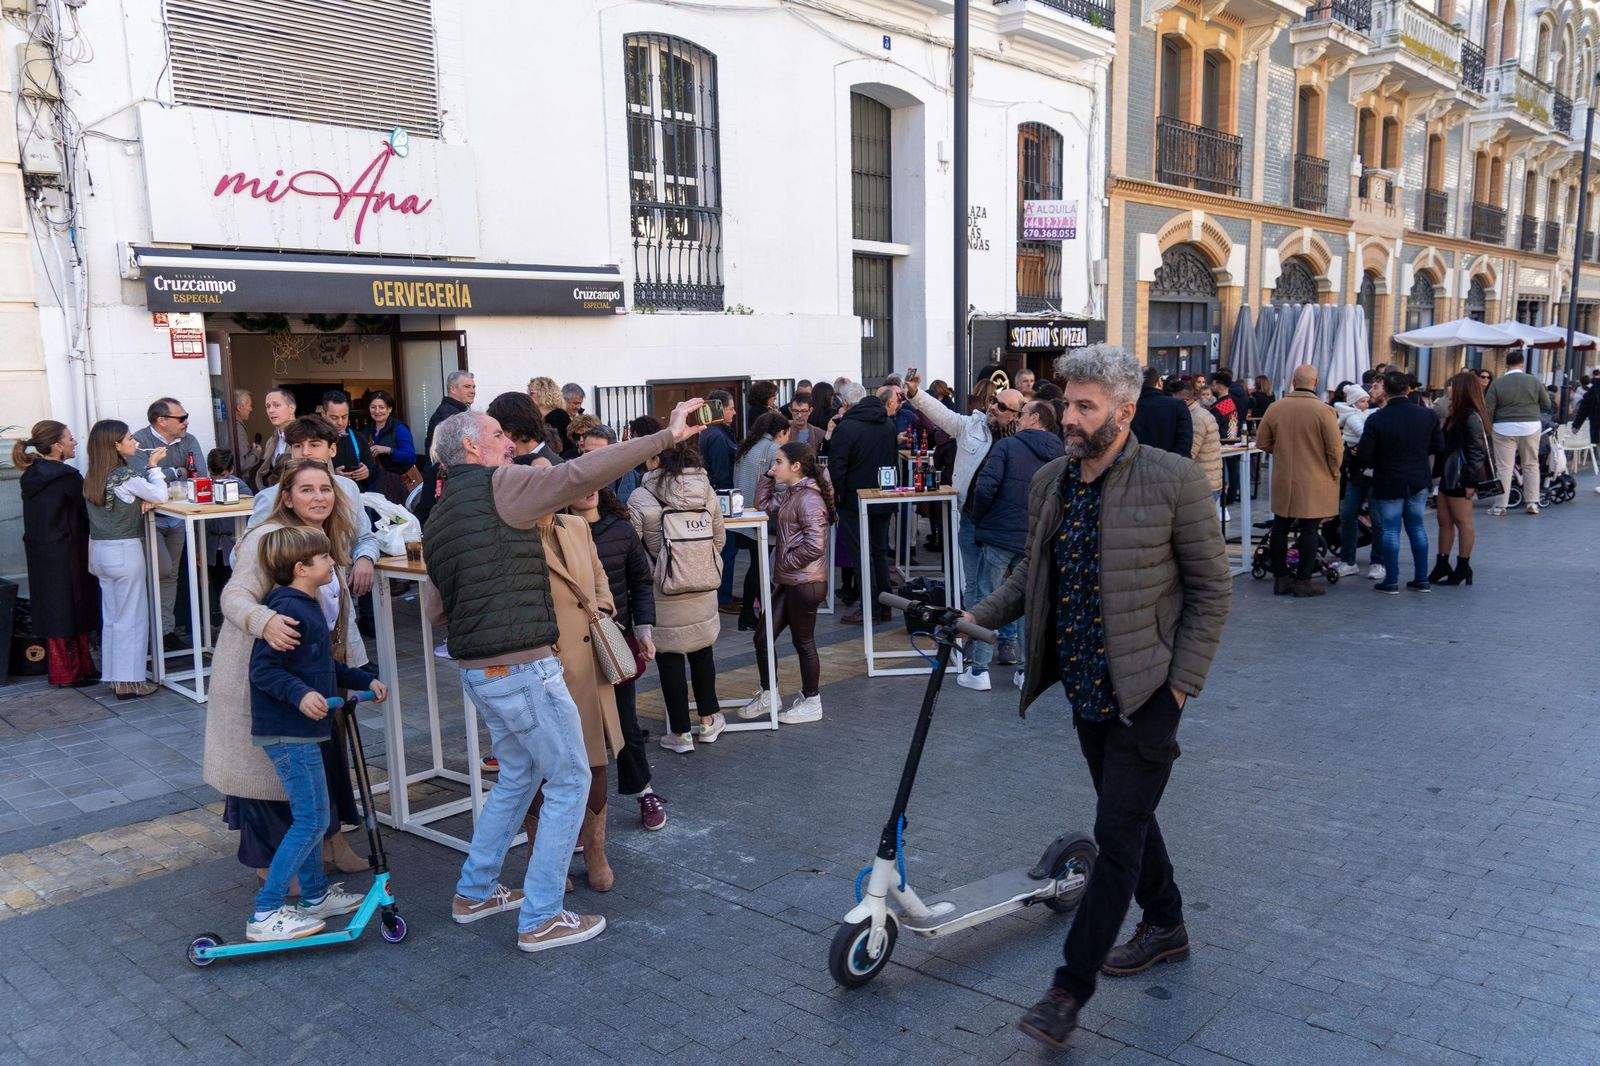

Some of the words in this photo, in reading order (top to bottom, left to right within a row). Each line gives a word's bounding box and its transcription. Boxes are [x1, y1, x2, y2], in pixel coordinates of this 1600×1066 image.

[214, 169, 290, 203] mi
[332, 140, 433, 245] Ana
[967, 205, 987, 219] AZA
[1036, 204, 1077, 214] ALQUILA
[967, 227, 982, 239] AS
[1023, 229, 1075, 238] 670.368.055
[967, 238, 990, 251] NJAS
[153, 275, 236, 294] Cruzcampo
[172, 293, 222, 304] ESPECIAL
[372, 280, 473, 308] CERVECERÍA
[573, 288, 620, 302] Cruzcampo
[1061, 327, 1088, 347] PIZZA
[884, 470, 891, 485] 9
[720, 496, 727, 514] 6
